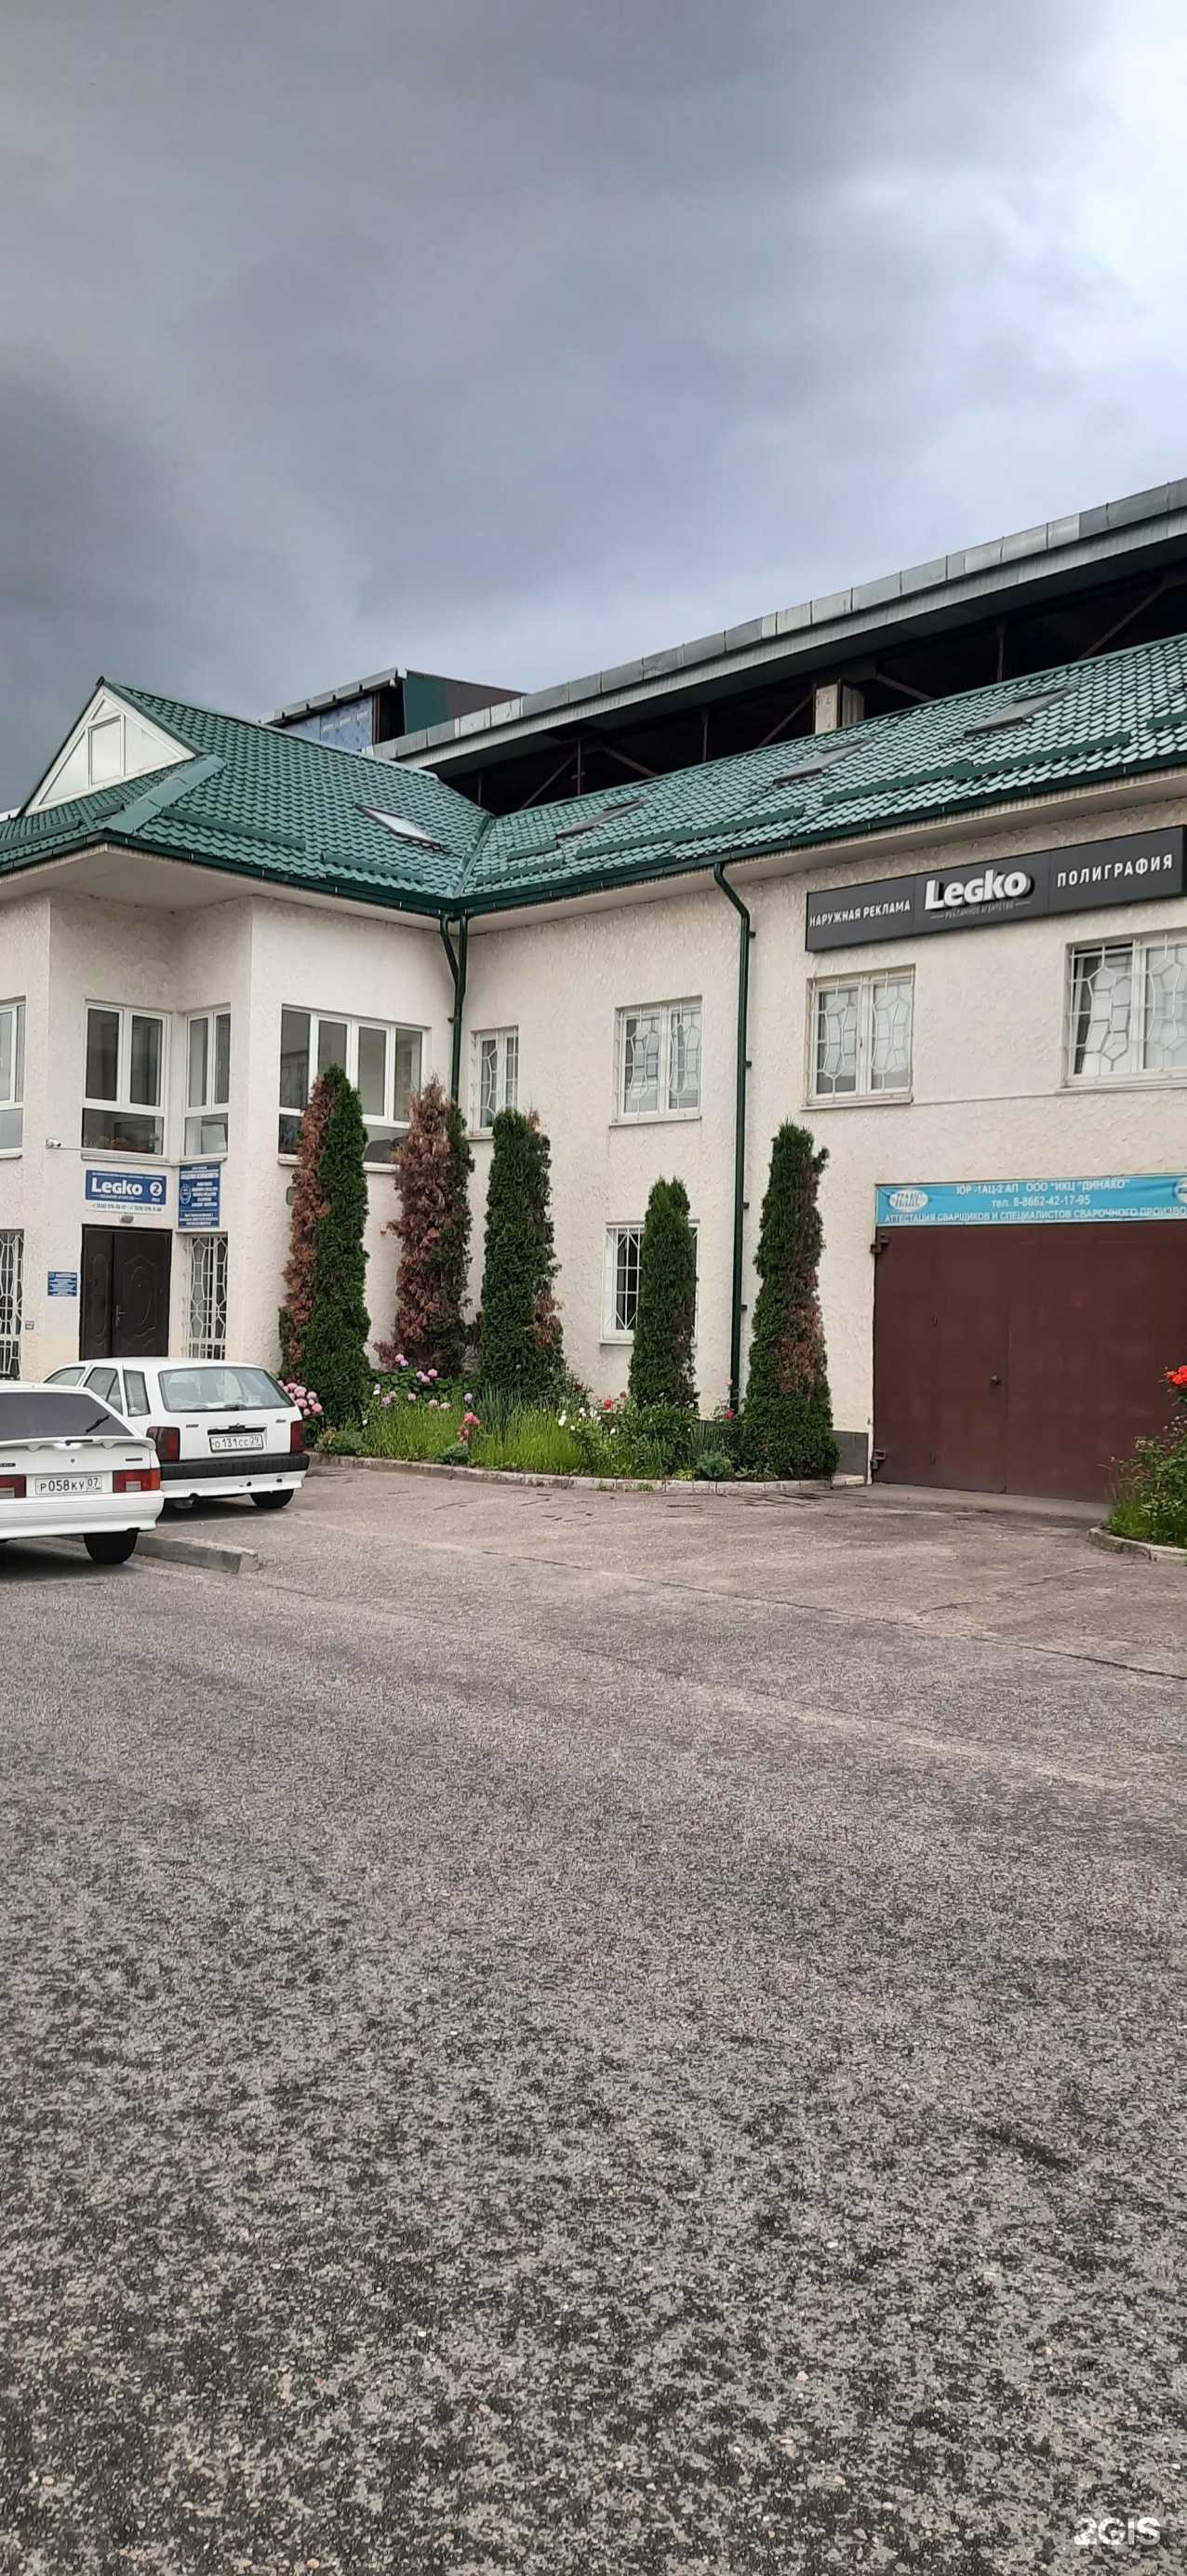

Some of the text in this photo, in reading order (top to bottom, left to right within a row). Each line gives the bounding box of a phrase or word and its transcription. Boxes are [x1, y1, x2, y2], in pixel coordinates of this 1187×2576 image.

[1057, 853, 1173, 888] ПОЛИГРАФИЯ
[925, 869, 1030, 910] Legko
[809, 900, 911, 928] НАРУЖНАЯ РЕКЛАМА
[91, 1176, 143, 1196] Legko
[1026, 1181, 1048, 1192] ООО
[992, 1194, 1091, 1208] тел. 8-8662-42-17-95
[885, 1213, 937, 1223] АТТЕСТАЦИЯ
[938, 1211, 990, 1222] СВАРЩИКОВ
[992, 1211, 999, 1221] И
[1000, 1209, 1072, 1221] СПЕЦИАЛИСТОВ
[1074, 1207, 1138, 1219] СВАРОЧНОГО
